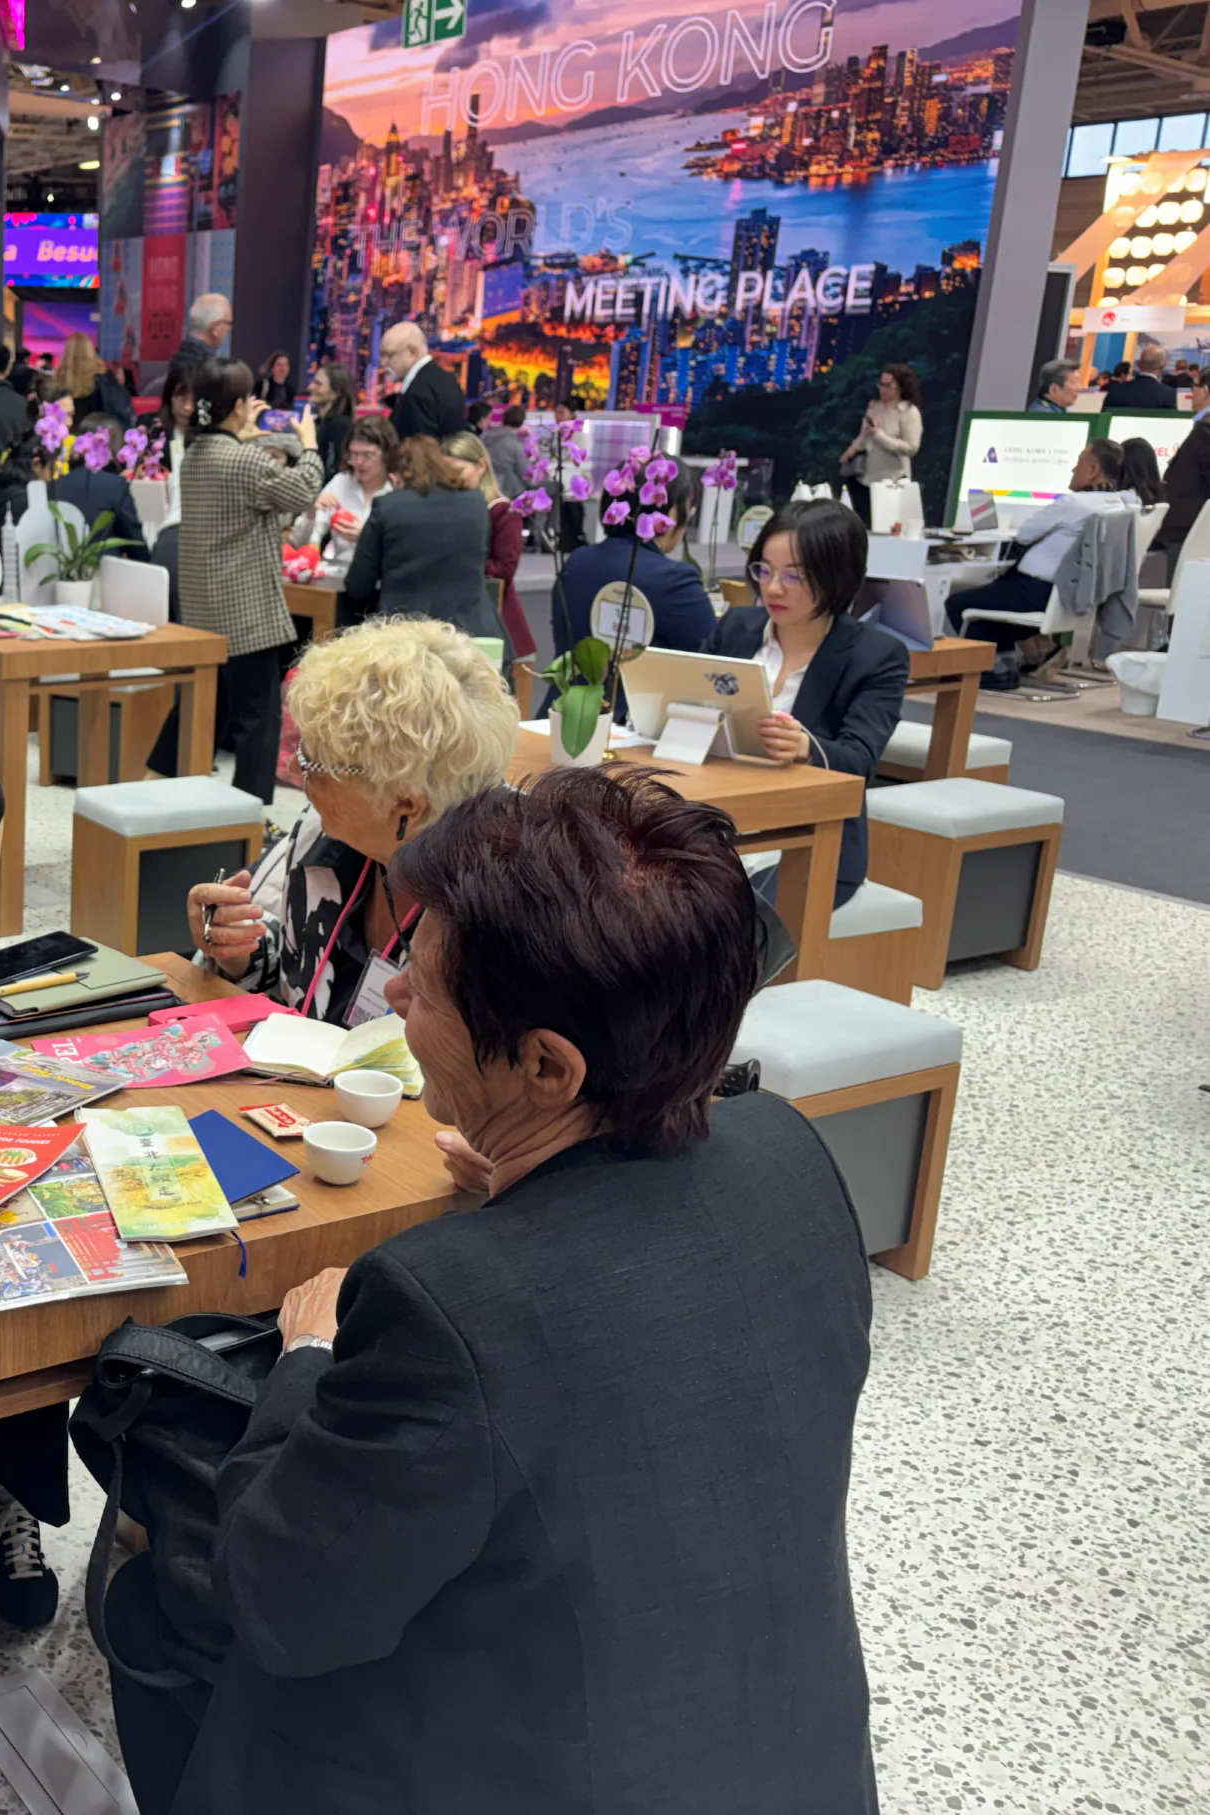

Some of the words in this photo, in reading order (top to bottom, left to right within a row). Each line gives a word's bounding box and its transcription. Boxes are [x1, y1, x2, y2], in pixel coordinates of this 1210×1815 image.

[420, 39, 597, 136] HONG
[616, 0, 838, 103] KONG
[563, 272, 728, 320] MEETING
[733, 263, 876, 313] PLACE
